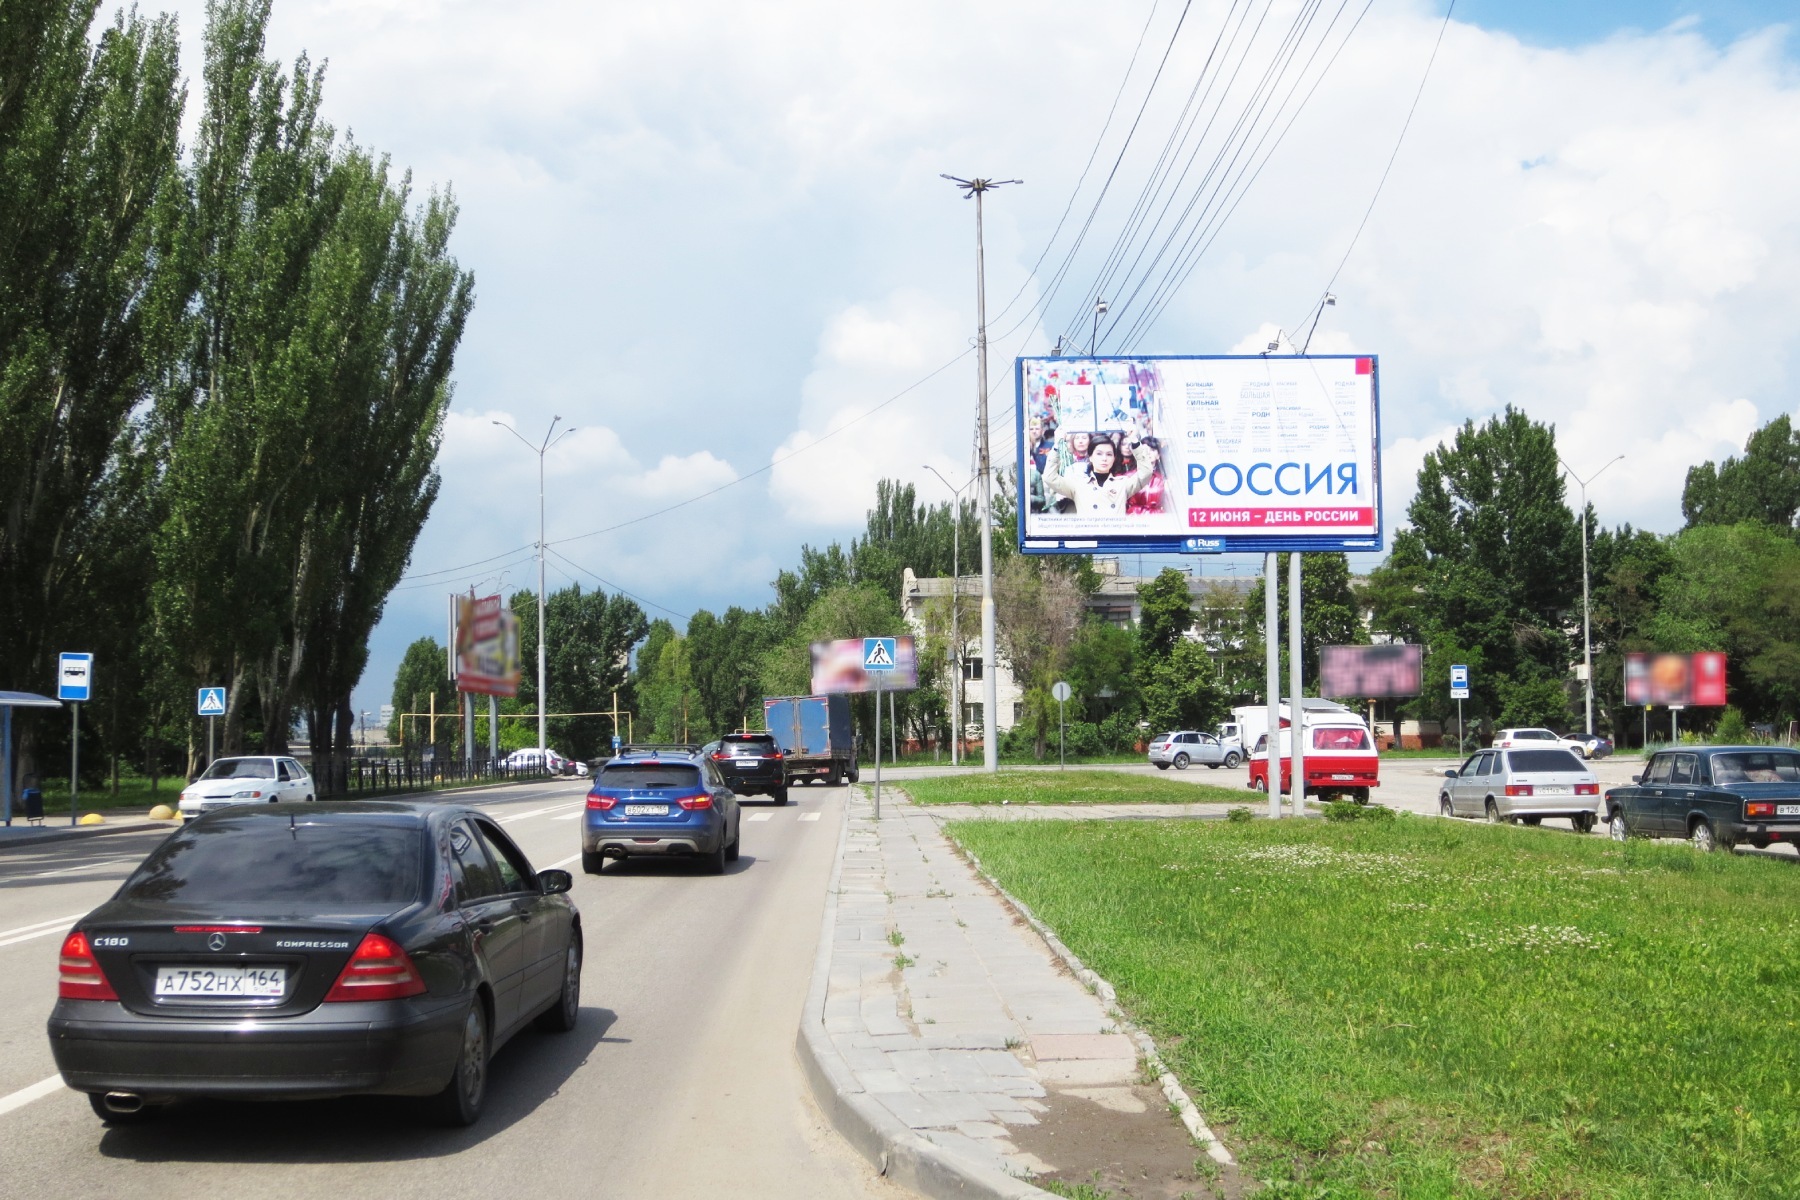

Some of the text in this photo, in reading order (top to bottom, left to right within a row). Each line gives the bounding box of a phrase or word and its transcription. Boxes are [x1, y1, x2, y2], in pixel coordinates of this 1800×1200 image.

[1187, 430, 1206, 438] СИЛ
[1187, 462, 1358, 496] РОССИЯ
[1191, 511, 1207, 522] 12
[1210, 511, 1250, 522] ИЮНЯ
[1264, 511, 1302, 523] ДЕНЬ
[1304, 510, 1359, 522] РОССИИ
[1197, 538, 1220, 547] Russ
[94, 937, 129, 946] C180
[276, 940, 349, 948] KOMPRESSOR
[248, 970, 281, 986] 164
